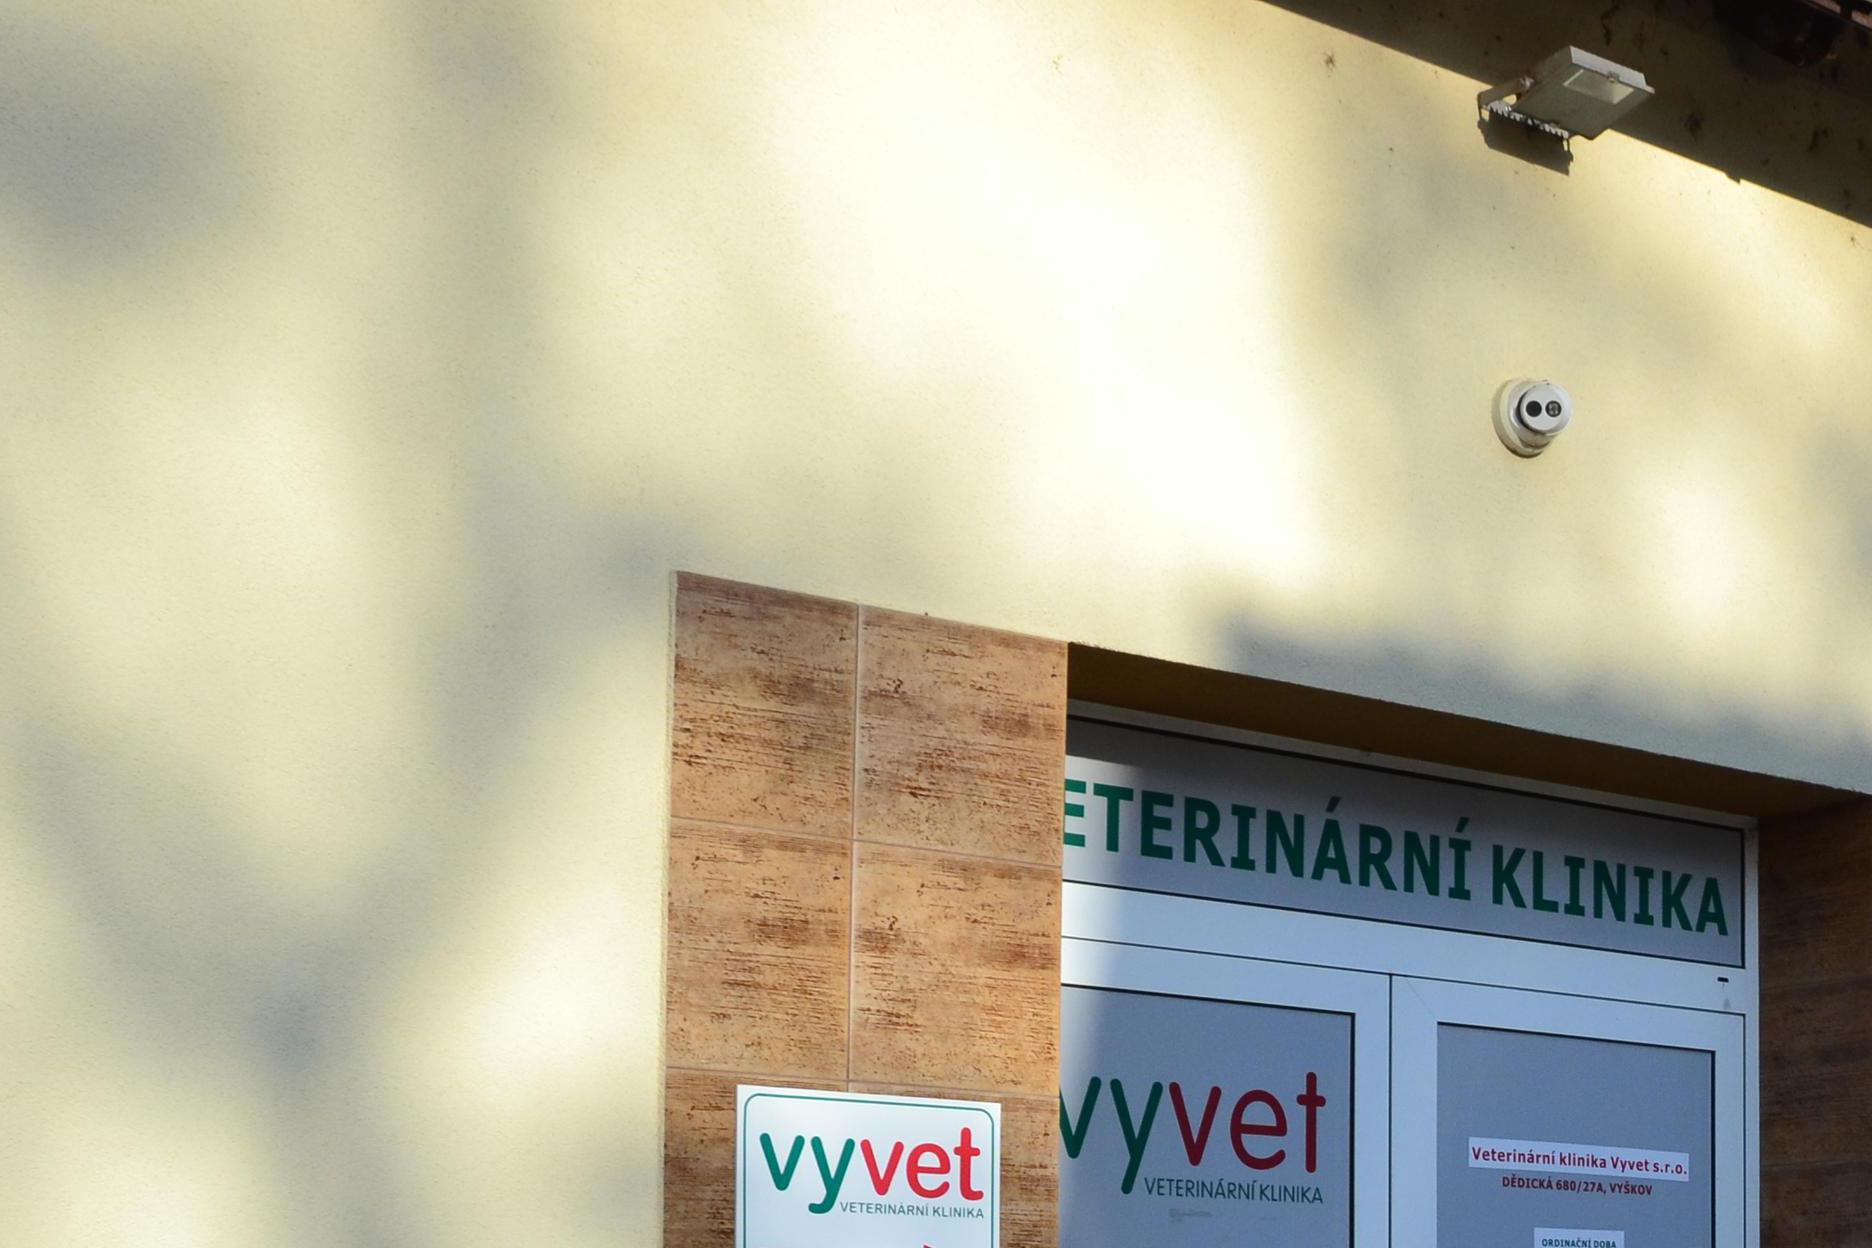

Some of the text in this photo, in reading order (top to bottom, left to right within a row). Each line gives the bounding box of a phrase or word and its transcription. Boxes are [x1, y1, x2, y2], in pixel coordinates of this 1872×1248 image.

[1063, 778, 1730, 937] ETERINÁRNÍ KLINIKA
[1059, 1071, 1327, 1195] vyvet
[759, 1126, 984, 1214] vyvet
[1472, 1146, 1688, 1176] Veterinární klinika Vyvet s.r.o.
[1144, 1177, 1324, 1205] VETERINÁRNÍ KLINIKA
[1502, 1173, 1653, 1196] DĚDICKÁ 680/27A, VYŠKOV
[840, 1200, 985, 1219] VETERINÁRNÍ KLINIKA
[1541, 1237, 1617, 1248] ORDINAČNÍ DOBA
